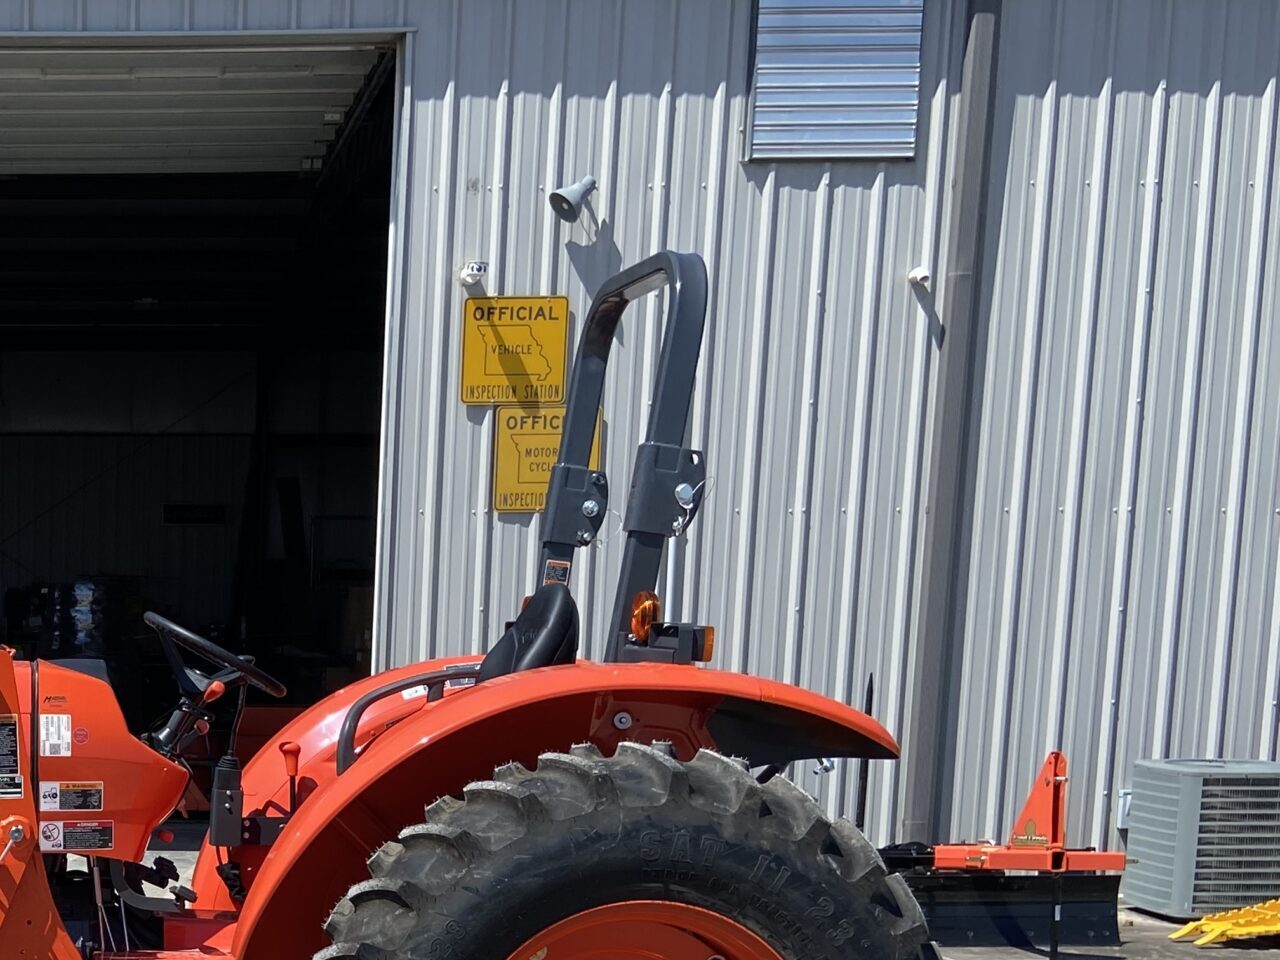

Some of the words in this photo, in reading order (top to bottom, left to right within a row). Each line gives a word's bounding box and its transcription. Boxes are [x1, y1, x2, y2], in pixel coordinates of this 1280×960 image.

[473, 306, 559, 321] OFFICIAL
[491, 345, 533, 355] VEHICLE
[466, 384, 517, 400] INSPECTION
[524, 384, 560, 399] STATION
[507, 415, 564, 430] OFFIC
[525, 447, 559, 458] MOTOR
[529, 462, 554, 472] CYCL
[499, 493, 545, 508] INSPECTIO
[640, 829, 727, 867] SAT
